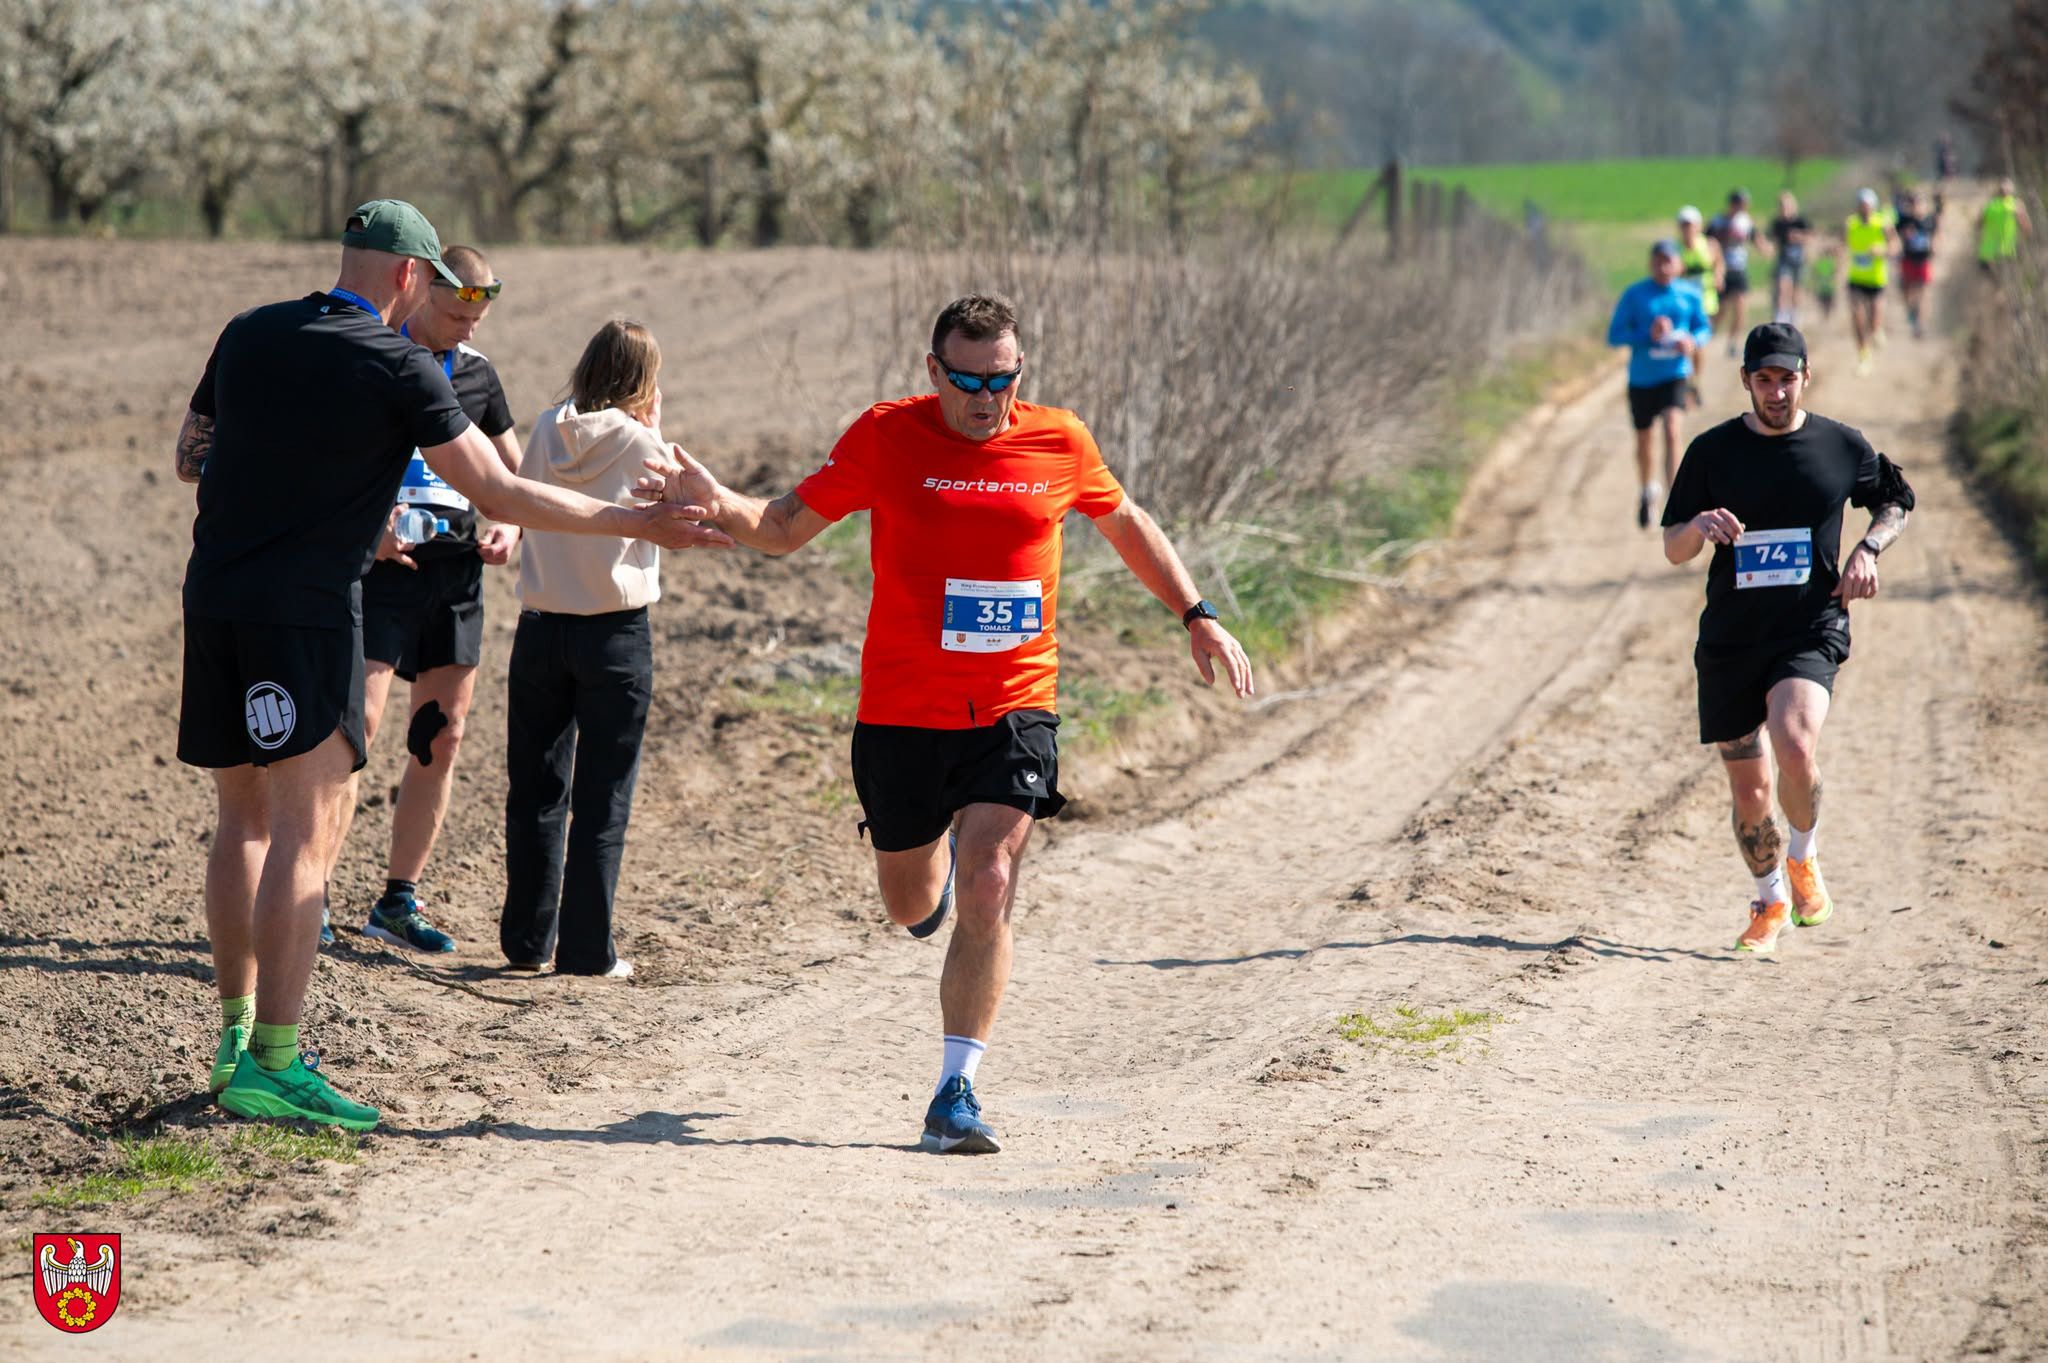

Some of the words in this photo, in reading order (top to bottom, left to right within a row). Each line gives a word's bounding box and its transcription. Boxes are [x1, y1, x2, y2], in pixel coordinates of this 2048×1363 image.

[923, 477, 1049, 495] sportano.pl
[1755, 544, 1788, 564] 74
[976, 600, 1013, 624] 35
